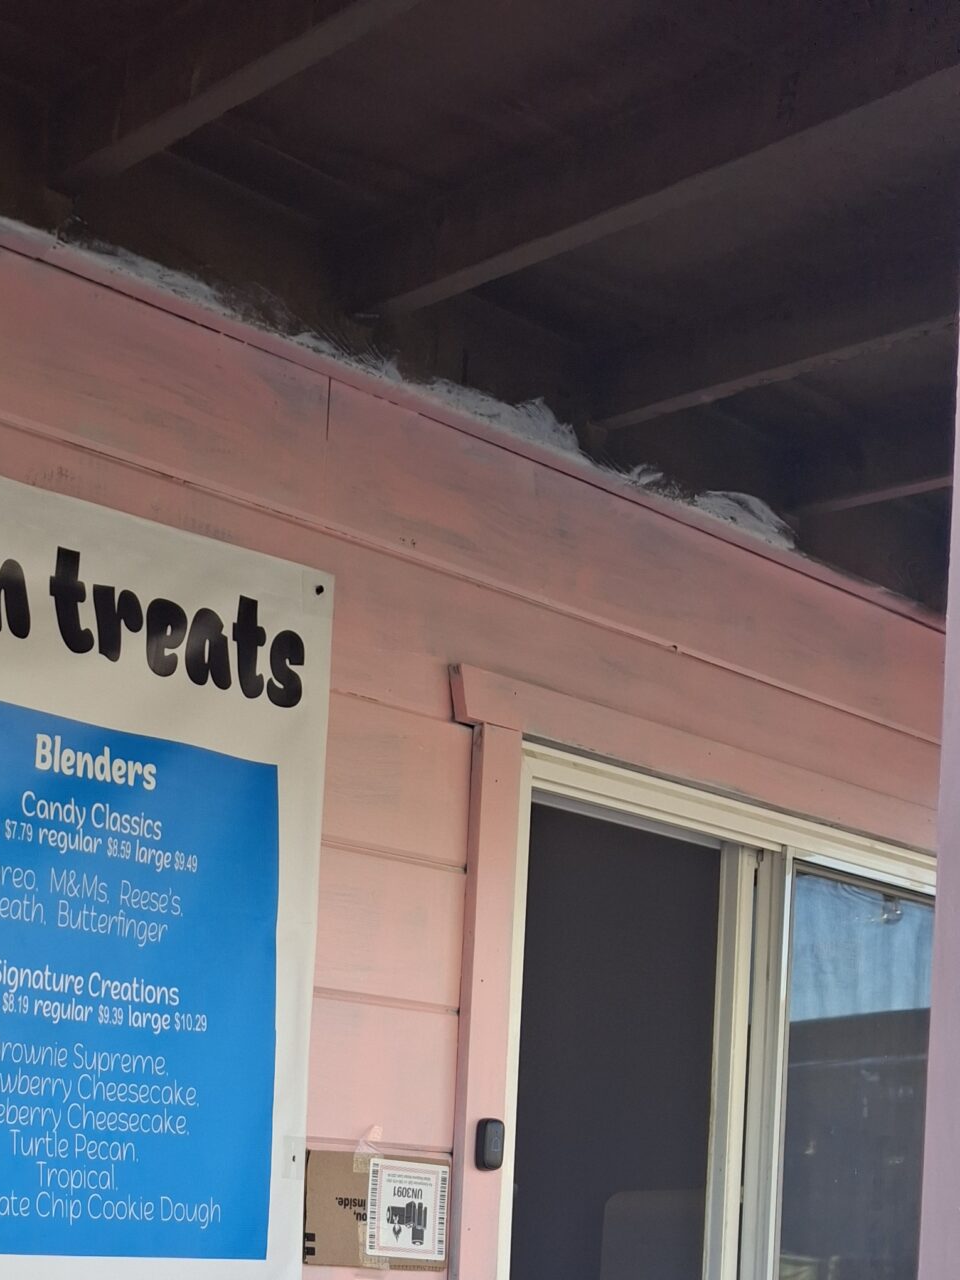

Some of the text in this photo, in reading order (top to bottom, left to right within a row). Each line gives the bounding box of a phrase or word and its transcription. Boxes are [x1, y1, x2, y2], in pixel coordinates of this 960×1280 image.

[50, 546, 305, 708] treats
[35, 733, 157, 790] Blenders
[21, 790, 162, 840] Candy Classics
[5, 818, 33, 842] $7.79
[38, 827, 102, 853] regular
[106, 837, 131, 859] $8.59
[135, 839, 172, 872] large
[174, 851, 198, 873] $9.49
[57, 900, 168, 947] Butterfinger
[88, 972, 180, 1006] Creations
[34, 998, 93, 1024] regular
[98, 1005, 123, 1025] $9.39
[128, 1005, 171, 1035] large
[174, 1013, 207, 1032] $10.29
[9, 1129, 69, 1158] Turtle
[36, 1191, 81, 1225] Chip
[87, 1193, 154, 1221] Cookie
[160, 1195, 221, 1229] Dough
[393, 1186, 423, 1200] UN3091
